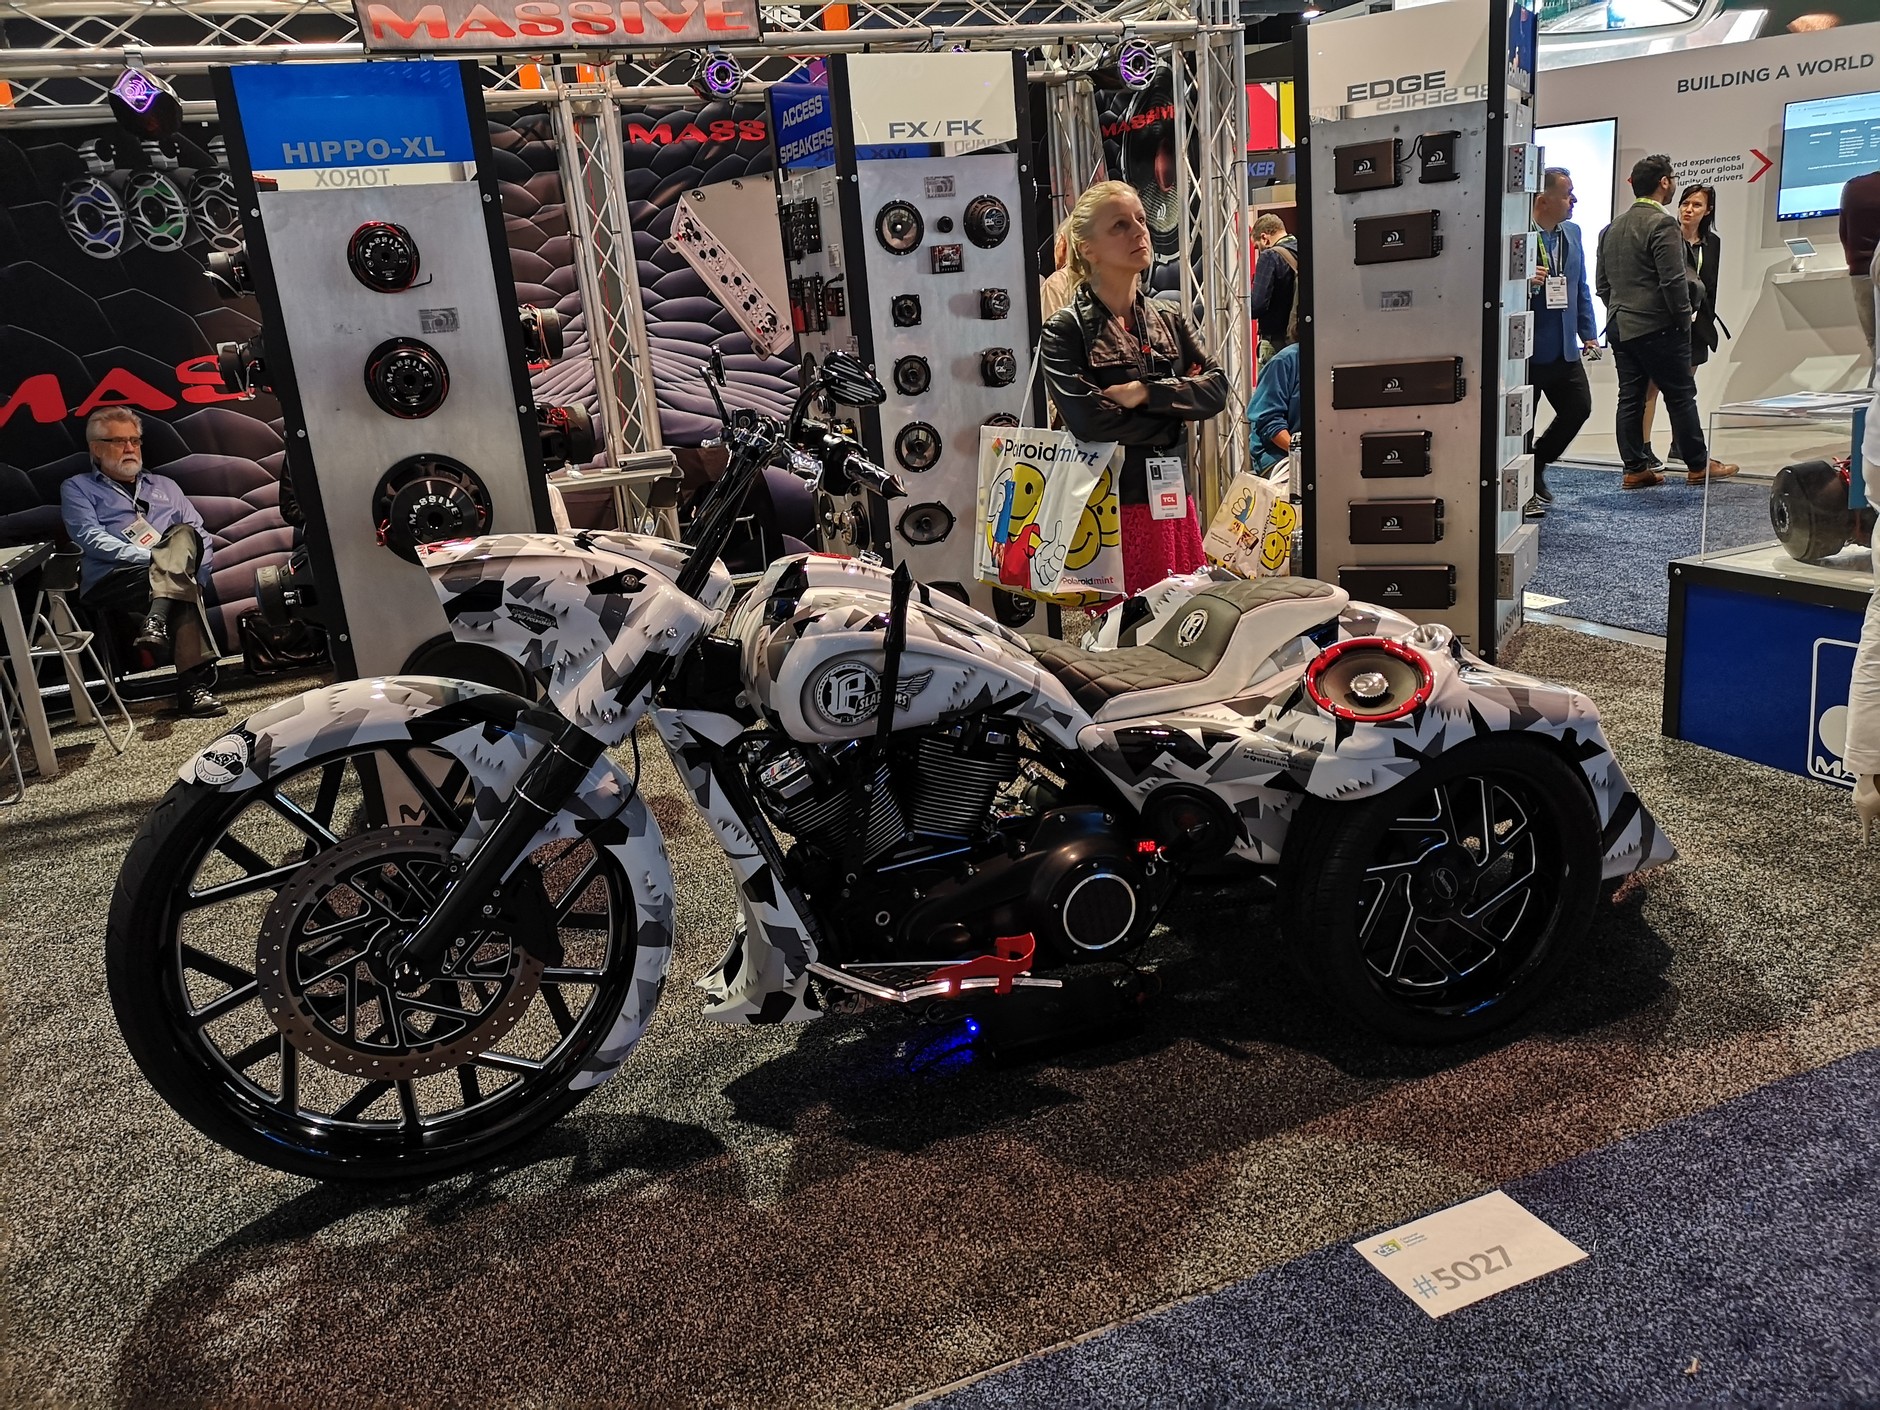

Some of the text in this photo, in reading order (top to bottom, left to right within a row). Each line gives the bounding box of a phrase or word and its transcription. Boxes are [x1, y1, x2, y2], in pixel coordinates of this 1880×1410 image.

[367, 0, 750, 39] MASSIVE
[1347, 70, 1446, 102] EDGE
[1677, 54, 1874, 93] BUILDING A WORLD
[782, 95, 824, 129] ACCESS
[627, 120, 766, 145] MASS
[889, 121, 928, 138] FX
[947, 119, 984, 136] FK
[282, 136, 446, 164] HIPPO-XL
[779, 127, 834, 164] SPEAKERS
[1688, 168, 1698, 177] by
[1700, 167, 1715, 175] our
[1717, 163, 1744, 174] global
[1690, 154, 1741, 166] experiences
[1703, 176, 1712, 184] of
[1714, 174, 1743, 183] drivers
[386, 359, 430, 383] MASSIVE
[409, 495, 459, 525] MASSIVE
[1377, 1244, 1398, 1256] CES
[1413, 1245, 1513, 1299] #5027
